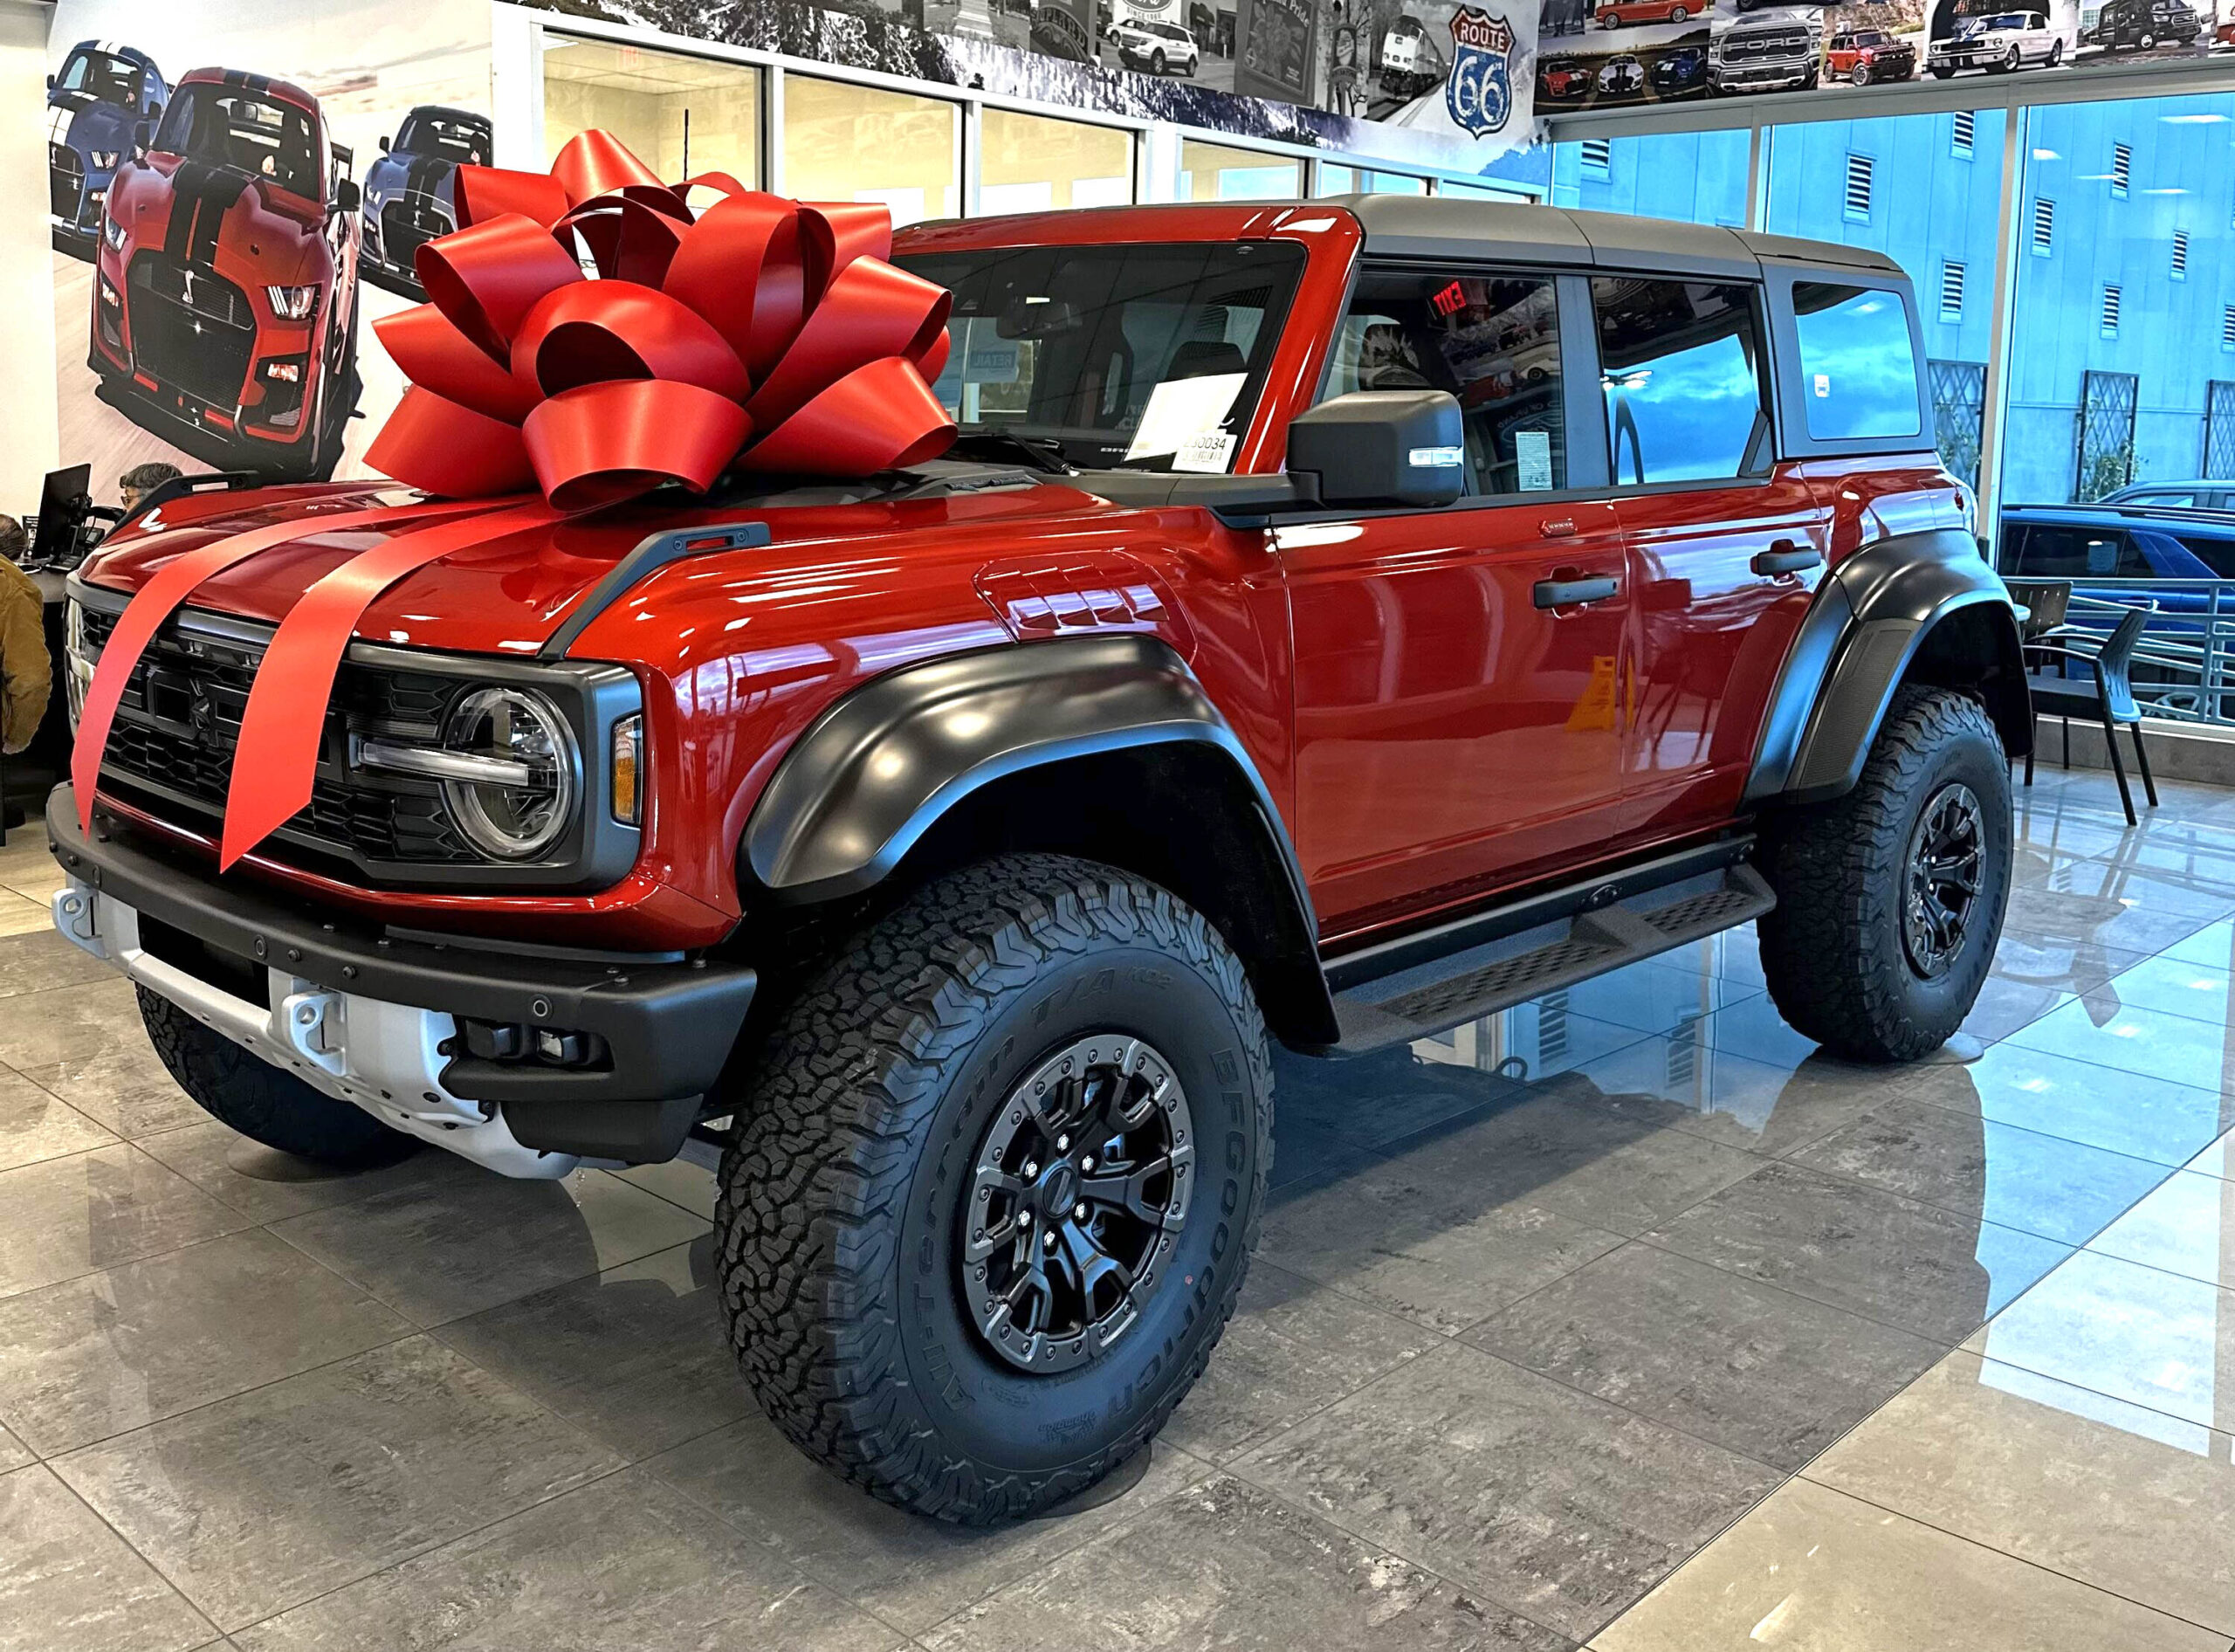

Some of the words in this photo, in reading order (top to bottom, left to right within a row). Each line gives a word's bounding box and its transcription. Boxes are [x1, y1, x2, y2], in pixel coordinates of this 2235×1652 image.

[1460, 22, 1505, 50] ROUTE
[1725, 37, 1806, 52] FORD
[1454, 55, 1504, 123] 66
